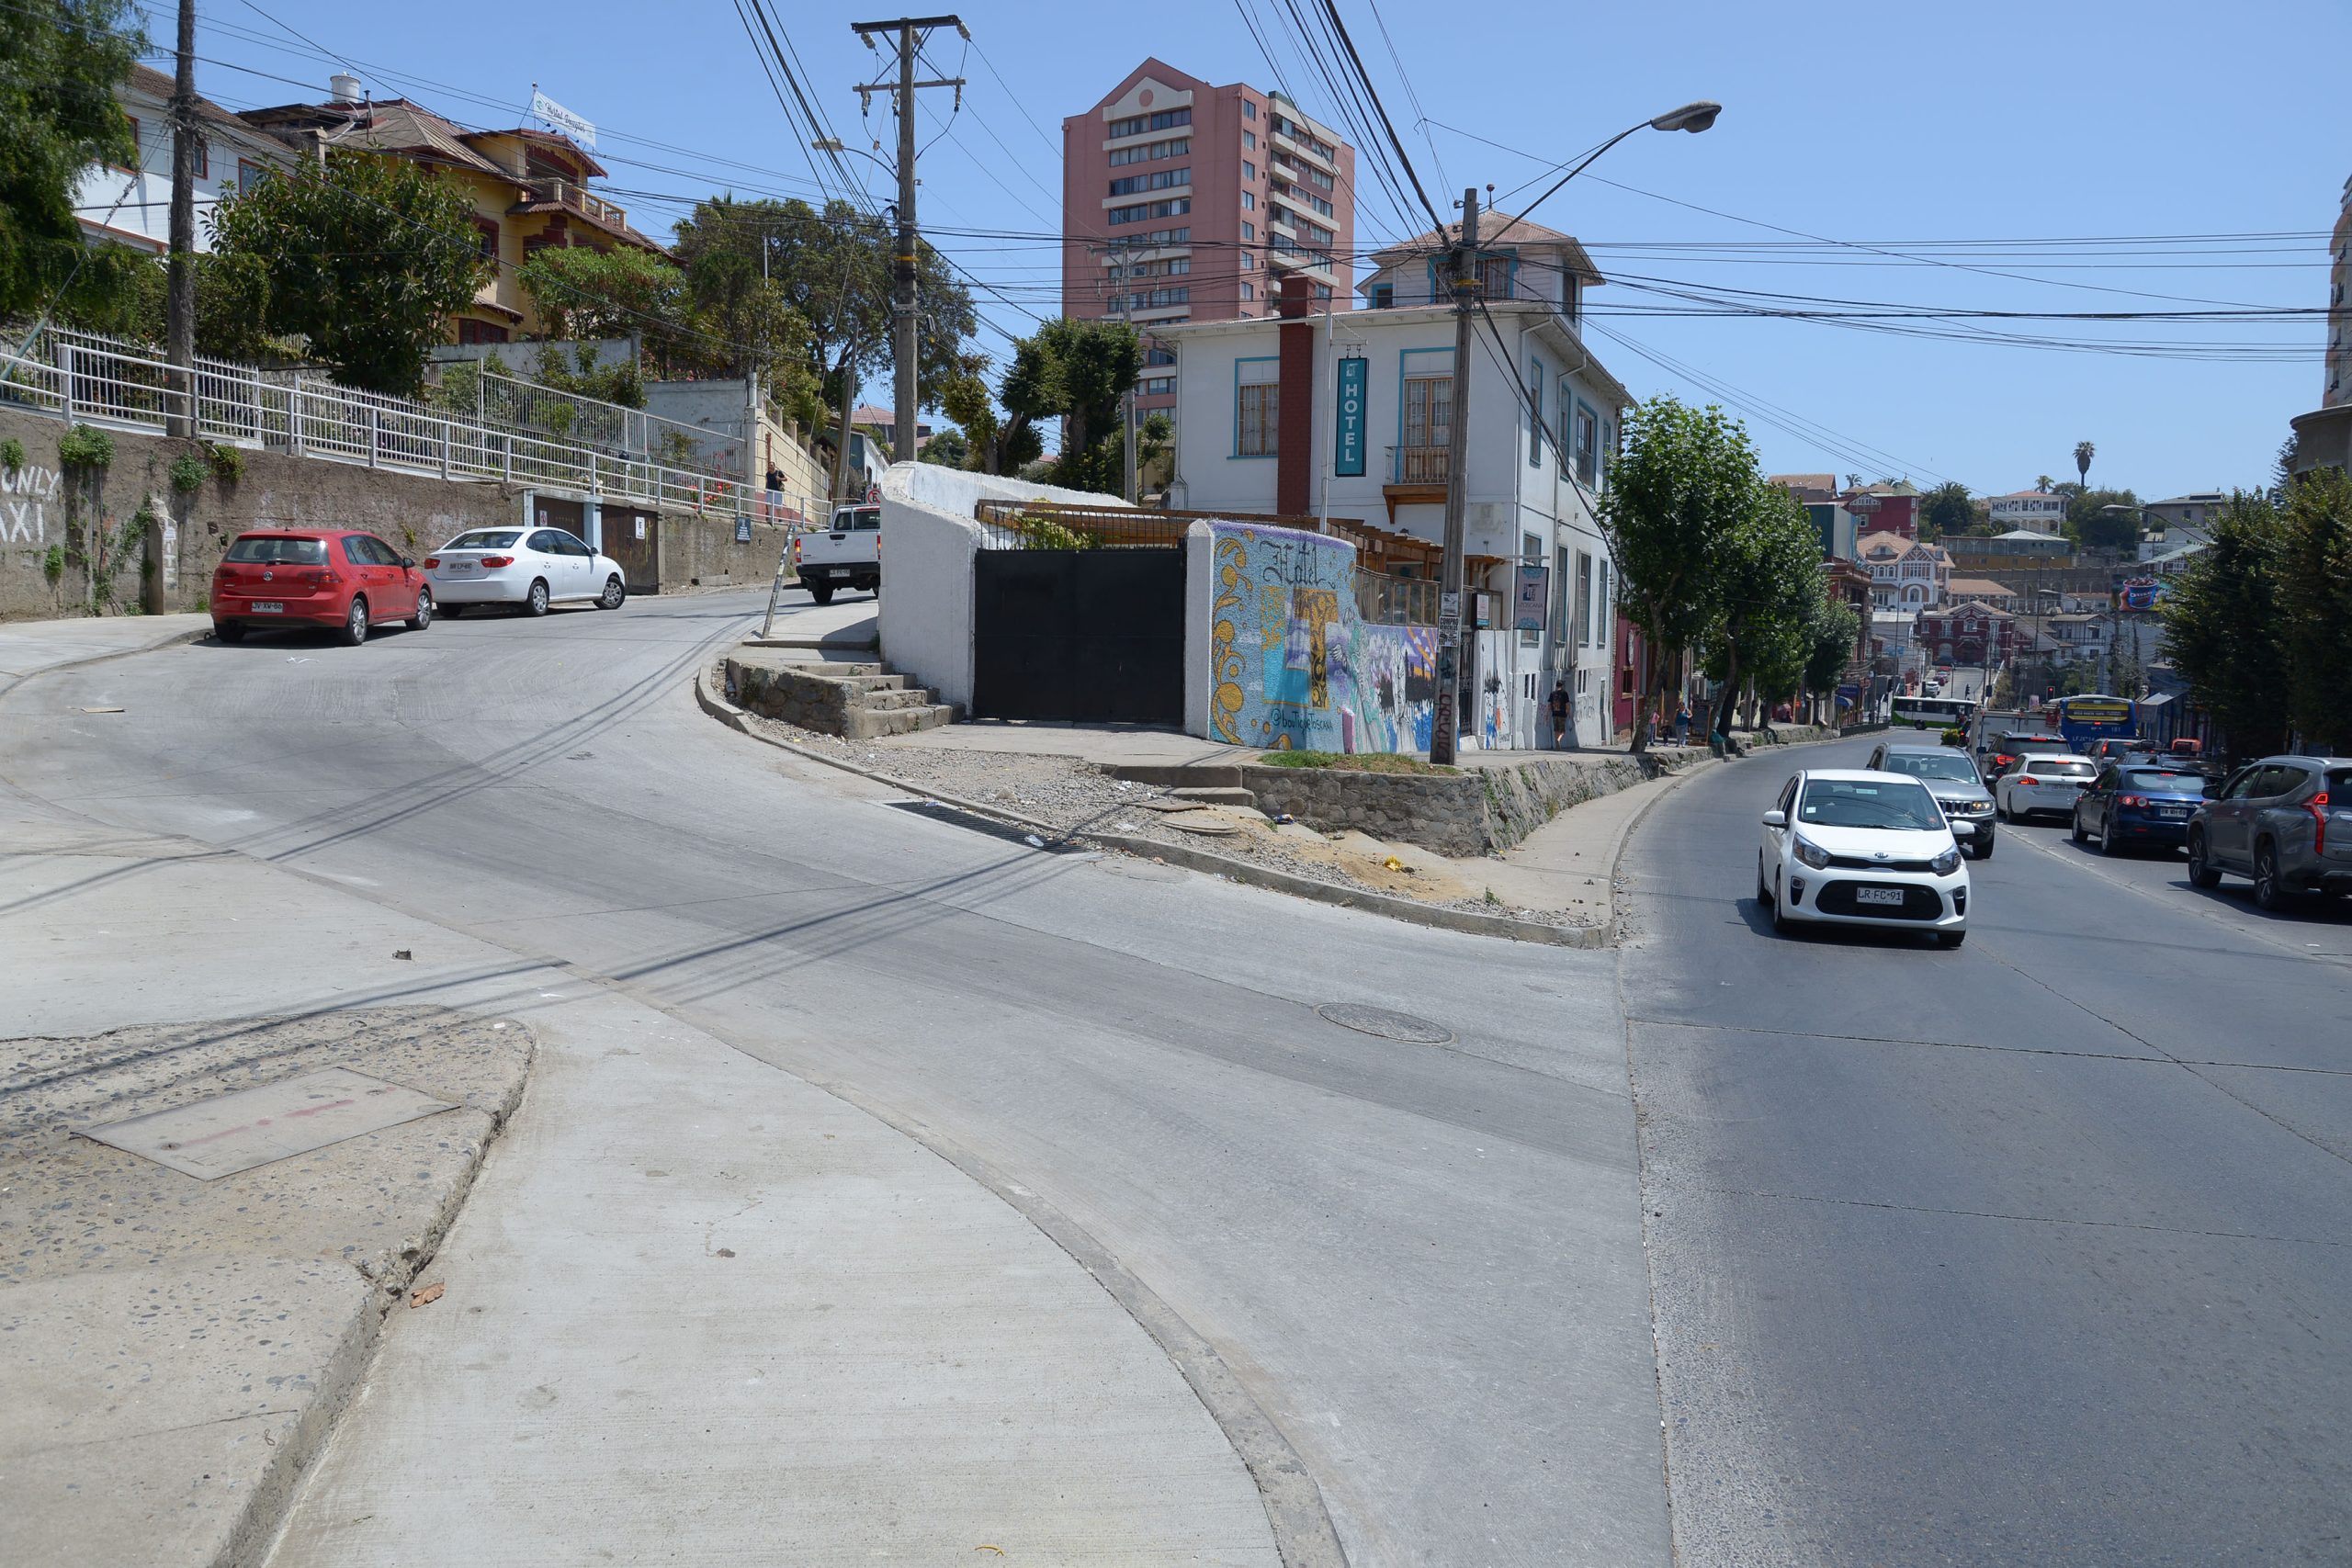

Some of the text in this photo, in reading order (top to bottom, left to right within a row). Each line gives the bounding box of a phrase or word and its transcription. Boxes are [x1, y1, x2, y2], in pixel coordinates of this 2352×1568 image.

[1344, 383, 1358, 462] HOTEL
[1, 465, 61, 501] ONLY
[1440, 617, 1459, 626] COMPRO
